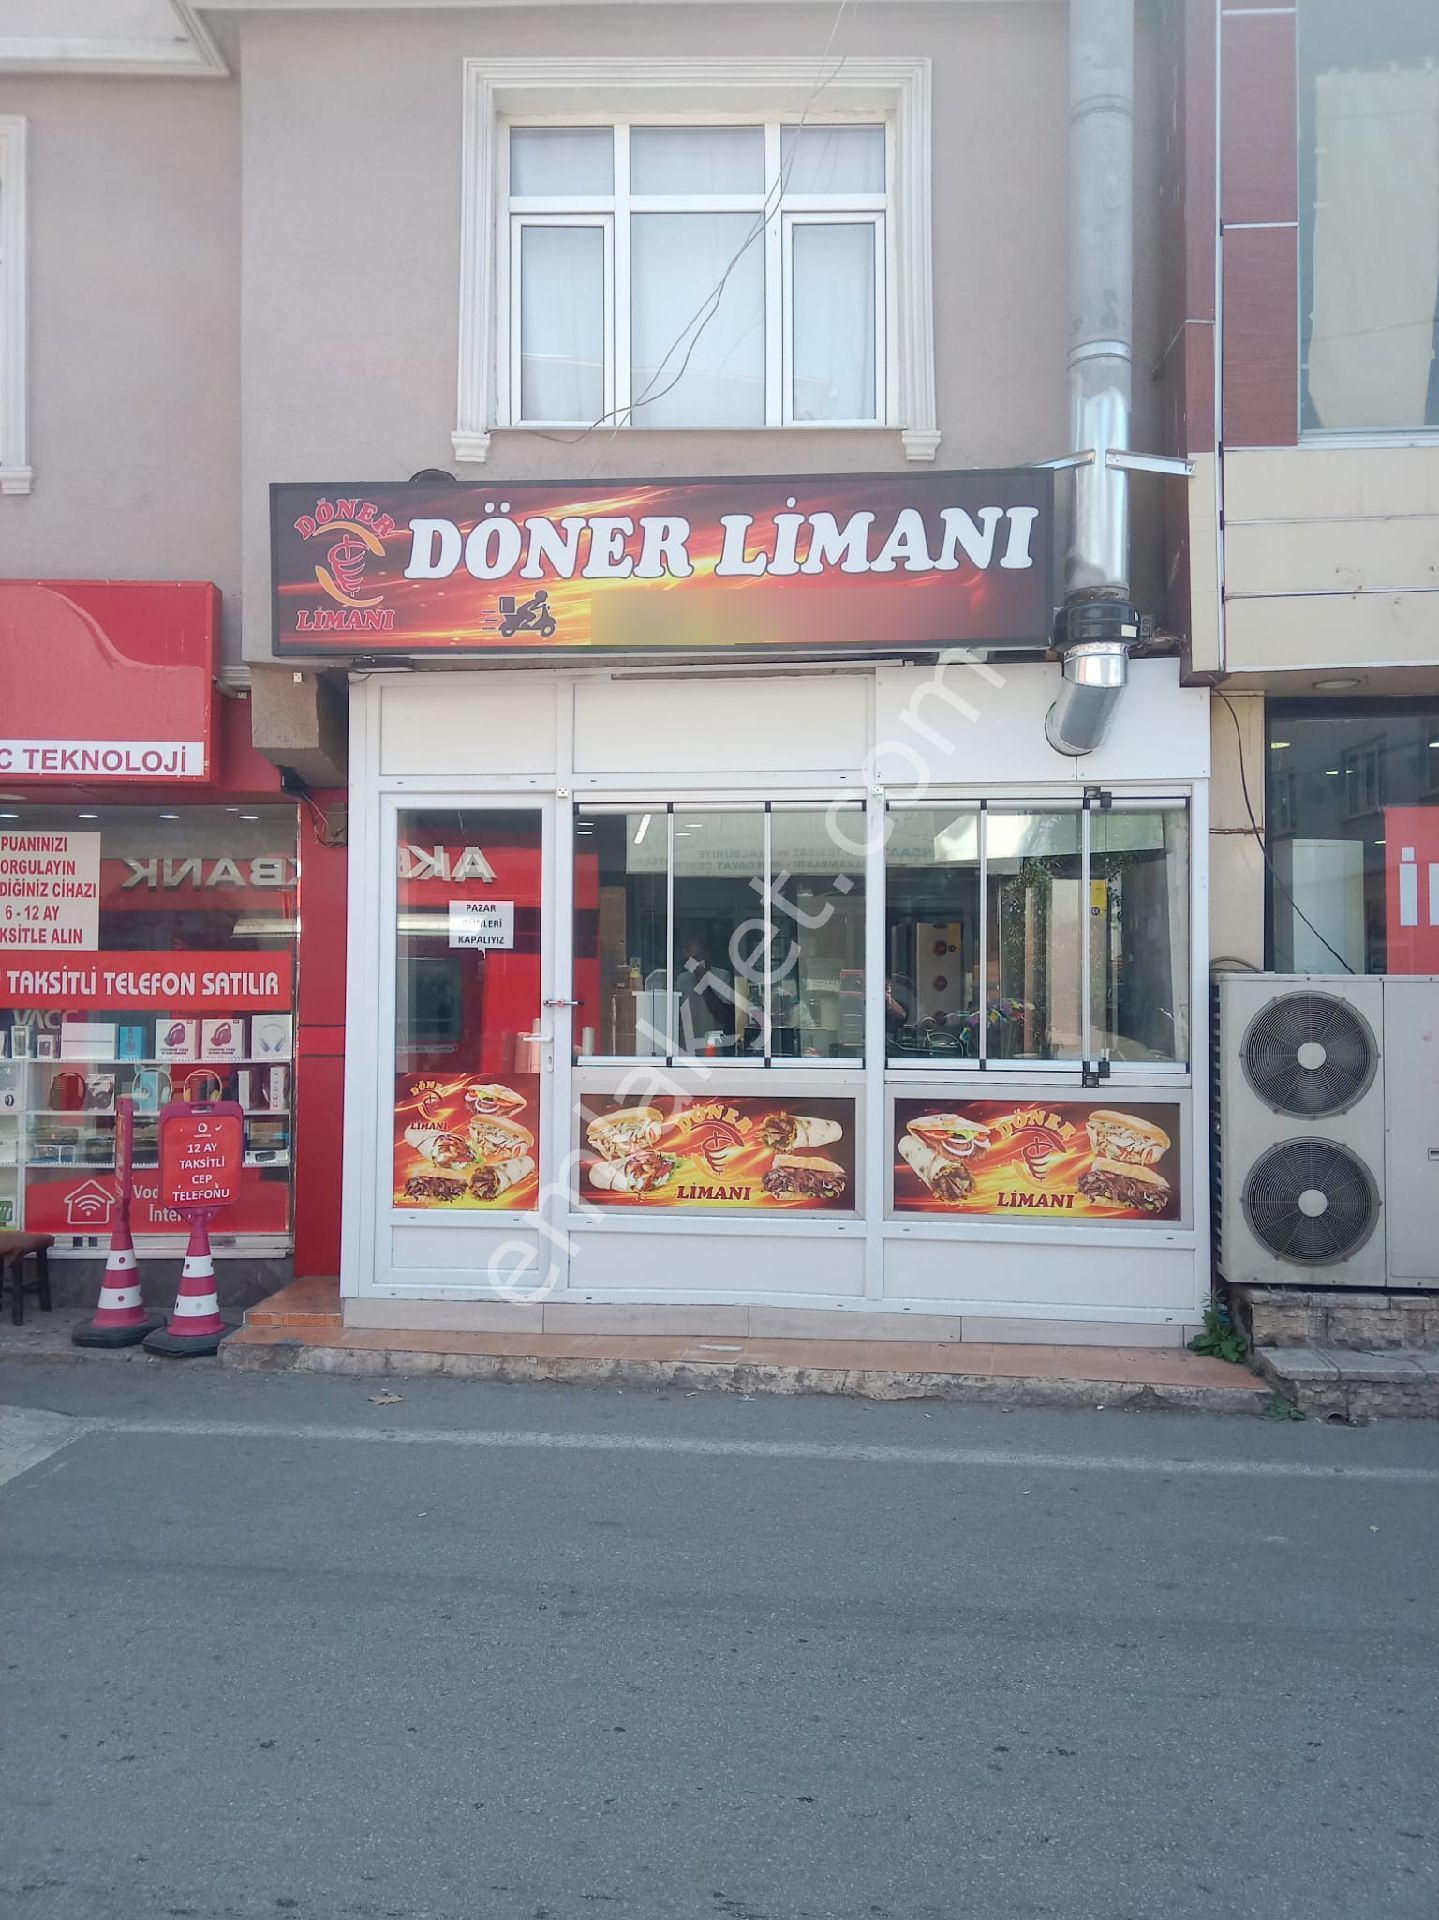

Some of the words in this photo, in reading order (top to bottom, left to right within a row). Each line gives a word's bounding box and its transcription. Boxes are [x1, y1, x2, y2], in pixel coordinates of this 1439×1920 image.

[293, 498, 396, 540] DÖNER
[403, 501, 694, 579] DÖNER
[714, 496, 1040, 577] LİMANI
[295, 605, 395, 631] LİMANI
[22, 745, 187, 772] TEKNOLOJİ
[1, 836, 67, 852] PUANINIZI
[52, 878, 97, 898] CİHAZI
[5, 905, 13, 920] 6
[24, 905, 39, 920] 12
[43, 905, 60, 920] AY
[466, 904, 497, 912] PAZAR
[51, 928, 82, 944] ALIN
[457, 936, 504, 944] KAPALIYIZ
[7, 965, 97, 995] TAKSİTLİ
[103, 972, 196, 996] TELEFON
[202, 972, 279, 996] SATILIR
[187, 1143, 201, 1154] 12
[203, 1143, 217, 1153] AY
[179, 1155, 225, 1170] TAKSİTLİ
[191, 1174, 213, 1185] CEP
[172, 1188, 230, 1202] TELEFONU
[676, 1182, 752, 1201] LİMANI
[996, 1189, 1075, 1209] LİMANI
